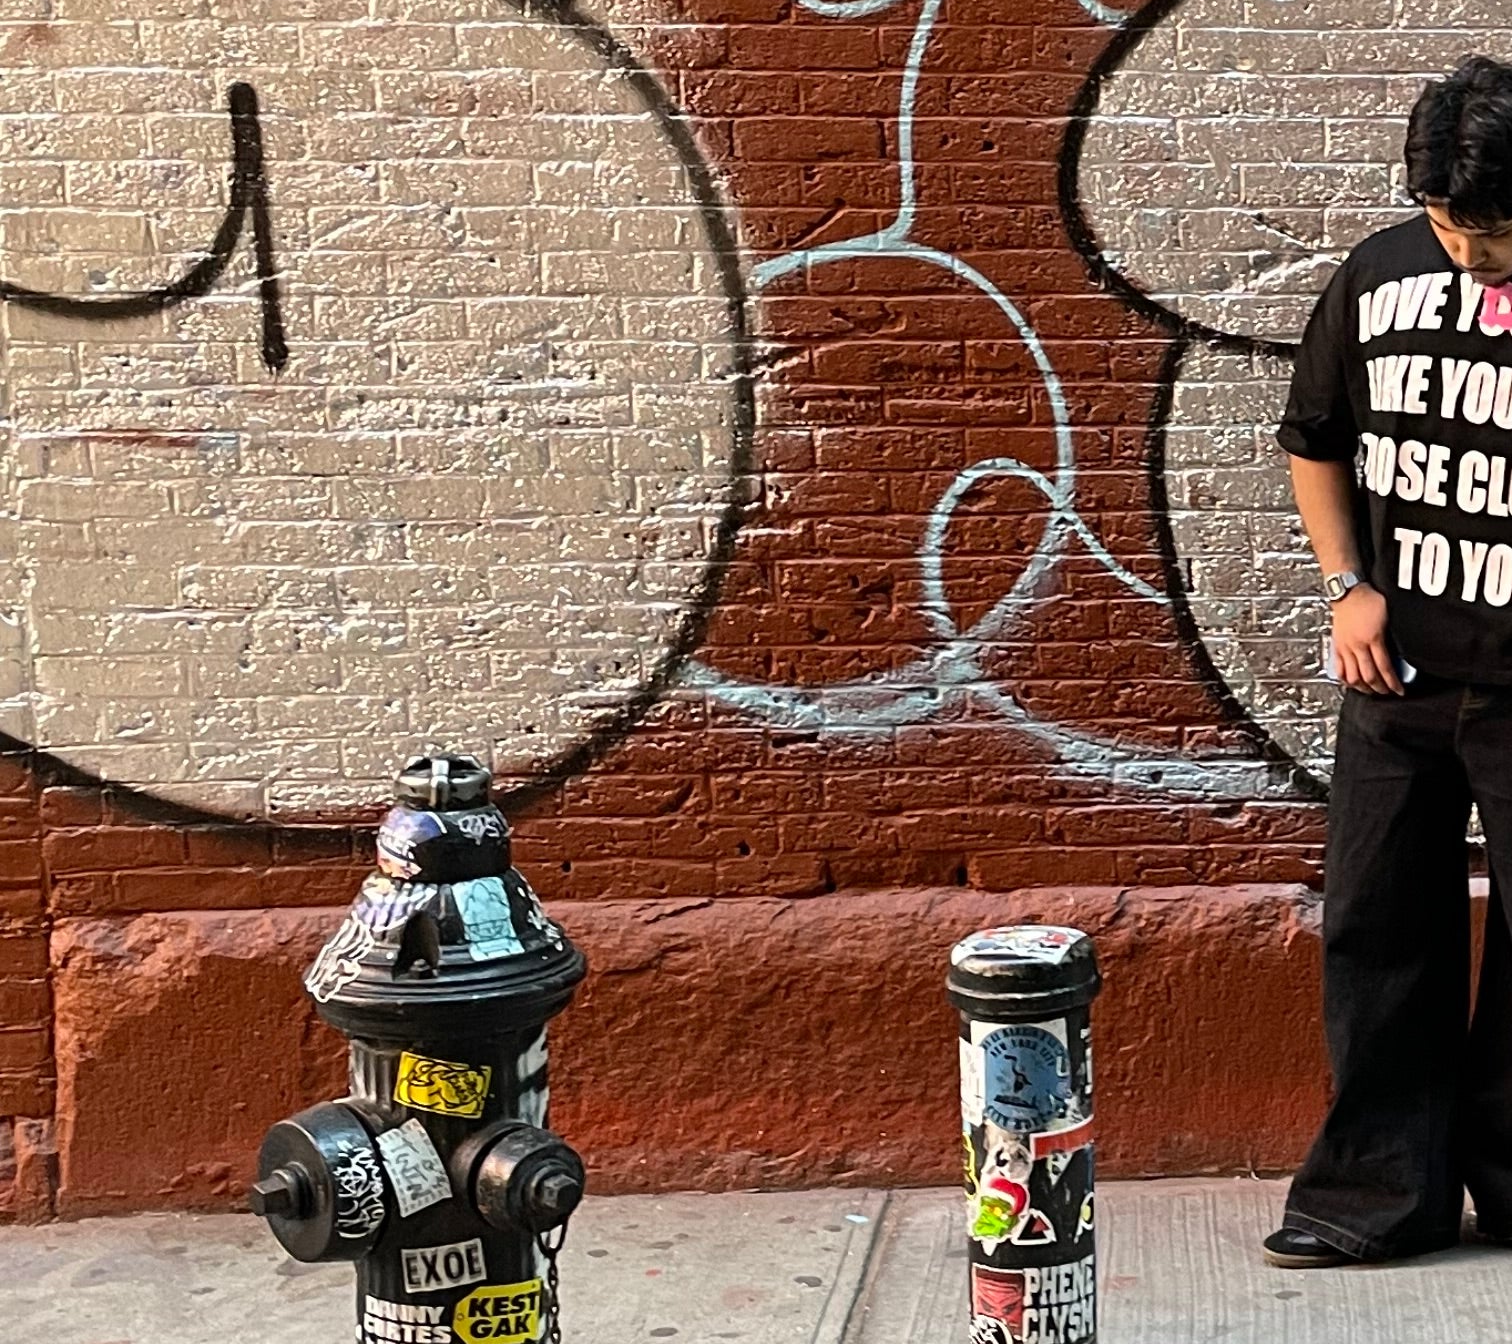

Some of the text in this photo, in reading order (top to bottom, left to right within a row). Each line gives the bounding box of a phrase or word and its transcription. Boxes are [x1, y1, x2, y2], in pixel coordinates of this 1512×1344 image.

[1355, 432, 1450, 507] OSE
[1394, 527, 1450, 596] TO
[403, 1243, 483, 1290] EXOE
[467, 1291, 540, 1318] KEST
[469, 1313, 532, 1339] GAK
